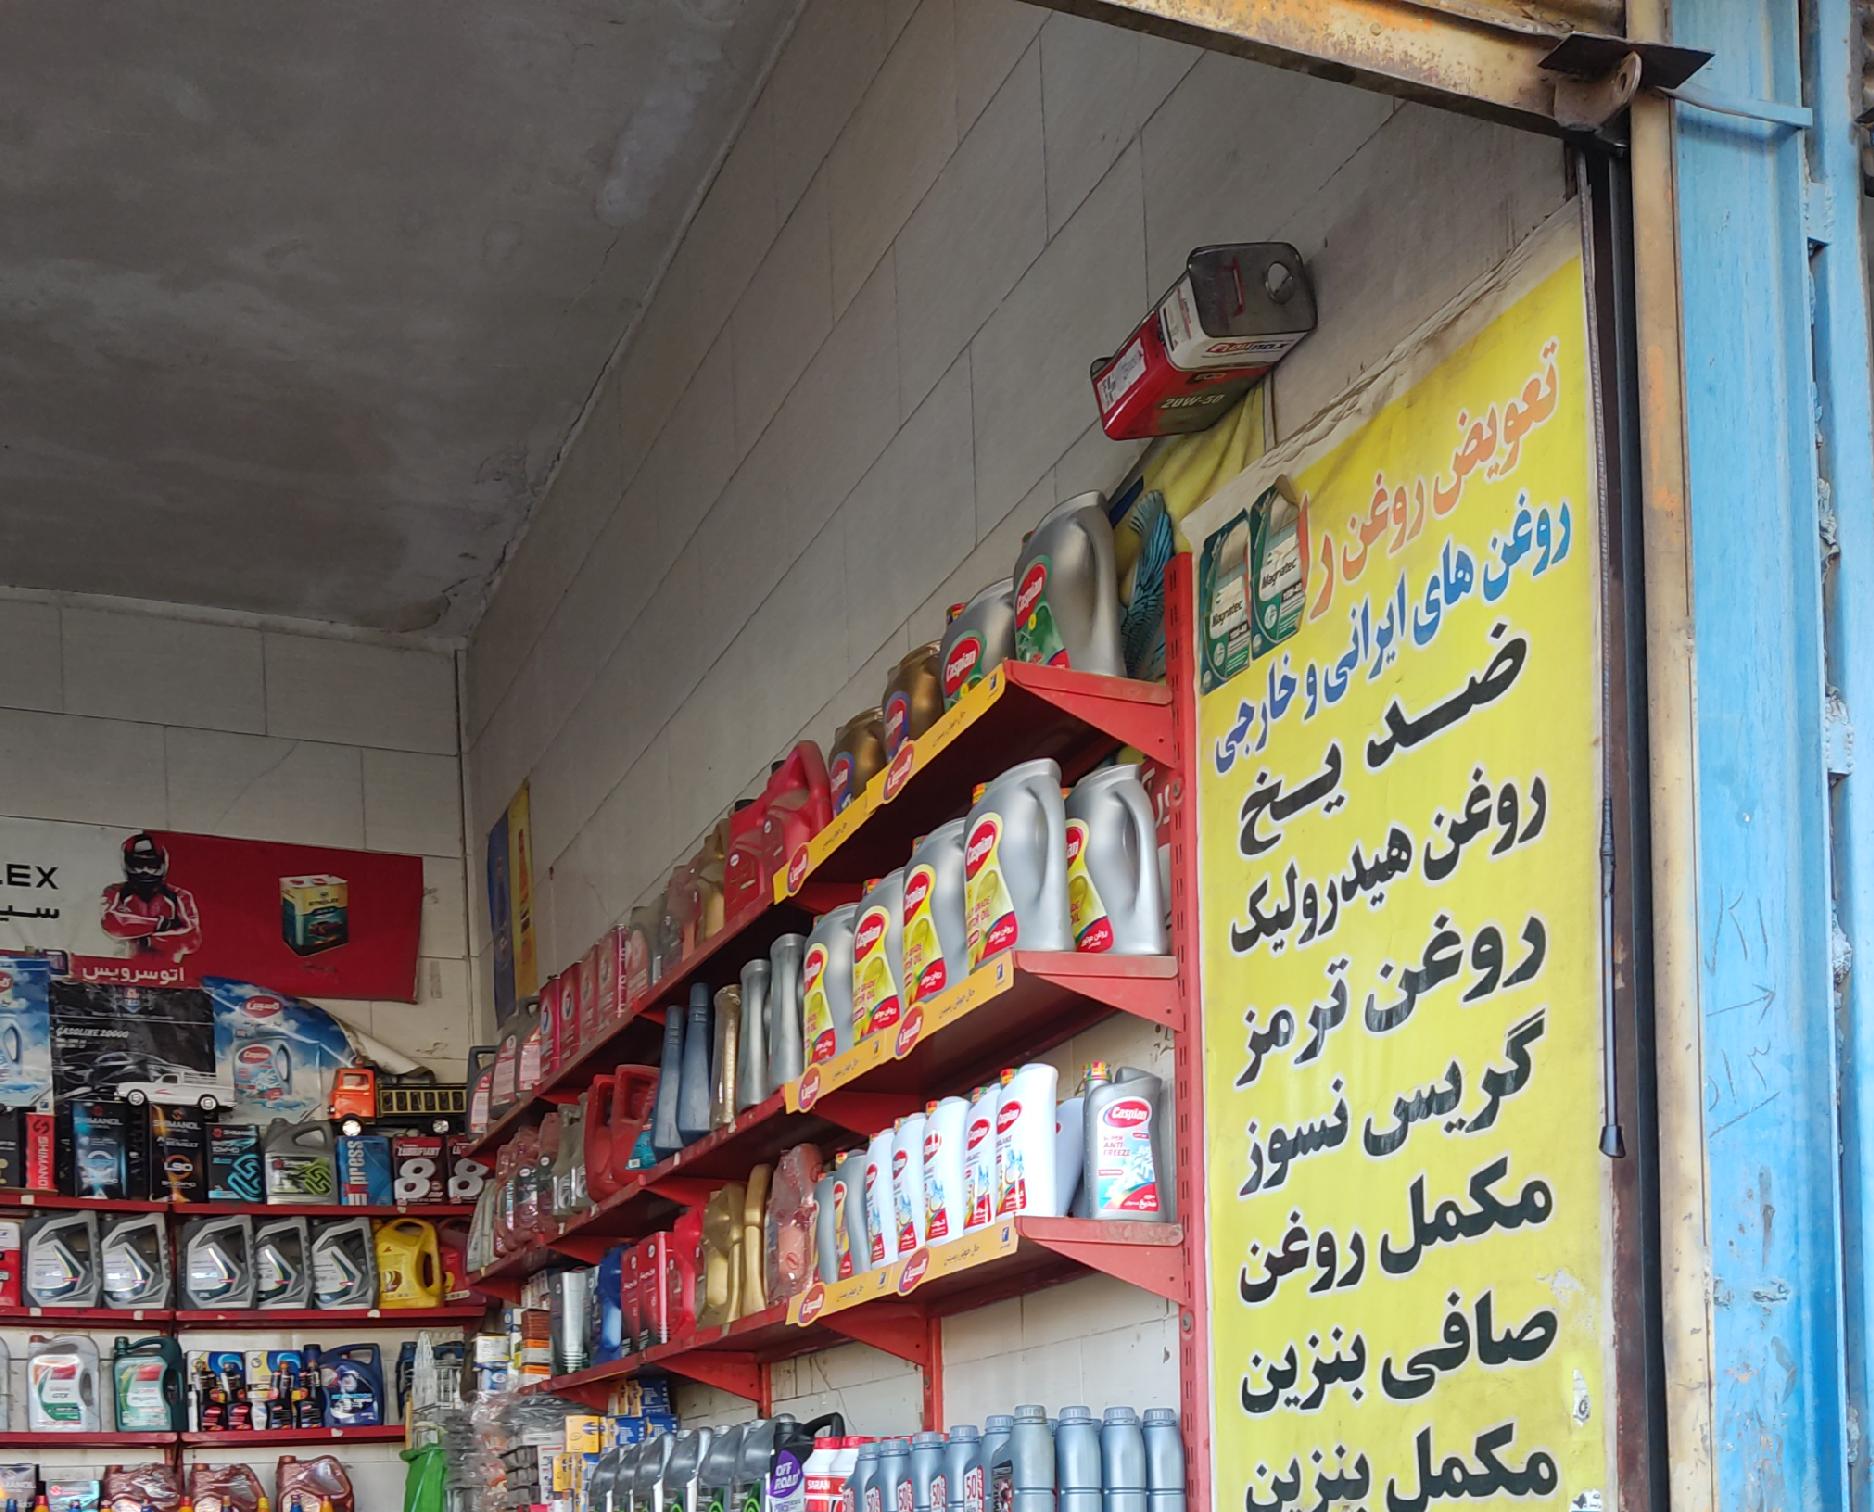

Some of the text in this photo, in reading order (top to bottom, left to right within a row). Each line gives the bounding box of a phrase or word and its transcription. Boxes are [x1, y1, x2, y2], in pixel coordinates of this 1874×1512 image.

[1433, 341, 1559, 516] تعویض
[1343, 473, 1423, 582] روغن
[945, 650, 977, 682] Caspian
[1216, 492, 1571, 773] روغن های ایرانی و خارجی
[1240, 623, 1527, 855] ضد یخ
[1231, 769, 1546, 953] روغن هیدرولیک
[82, 967, 184, 985] اتوسرویس
[1237, 914, 1545, 1086] روغن ترمز
[1111, 1107, 1147, 1120] Caspian
[1240, 1009, 1545, 1194] گریس نسوز
[394, 1158, 436, 1200] 8
[448, 1158, 489, 1198] 8
[1240, 1157, 1552, 1302] مکمل روغن
[1241, 1290, 1556, 1412] صافی بنزین
[774, 1474, 798, 1490] ROAD
[776, 1462, 792, 1476] OFF
[966, 1475, 976, 1500] 50
